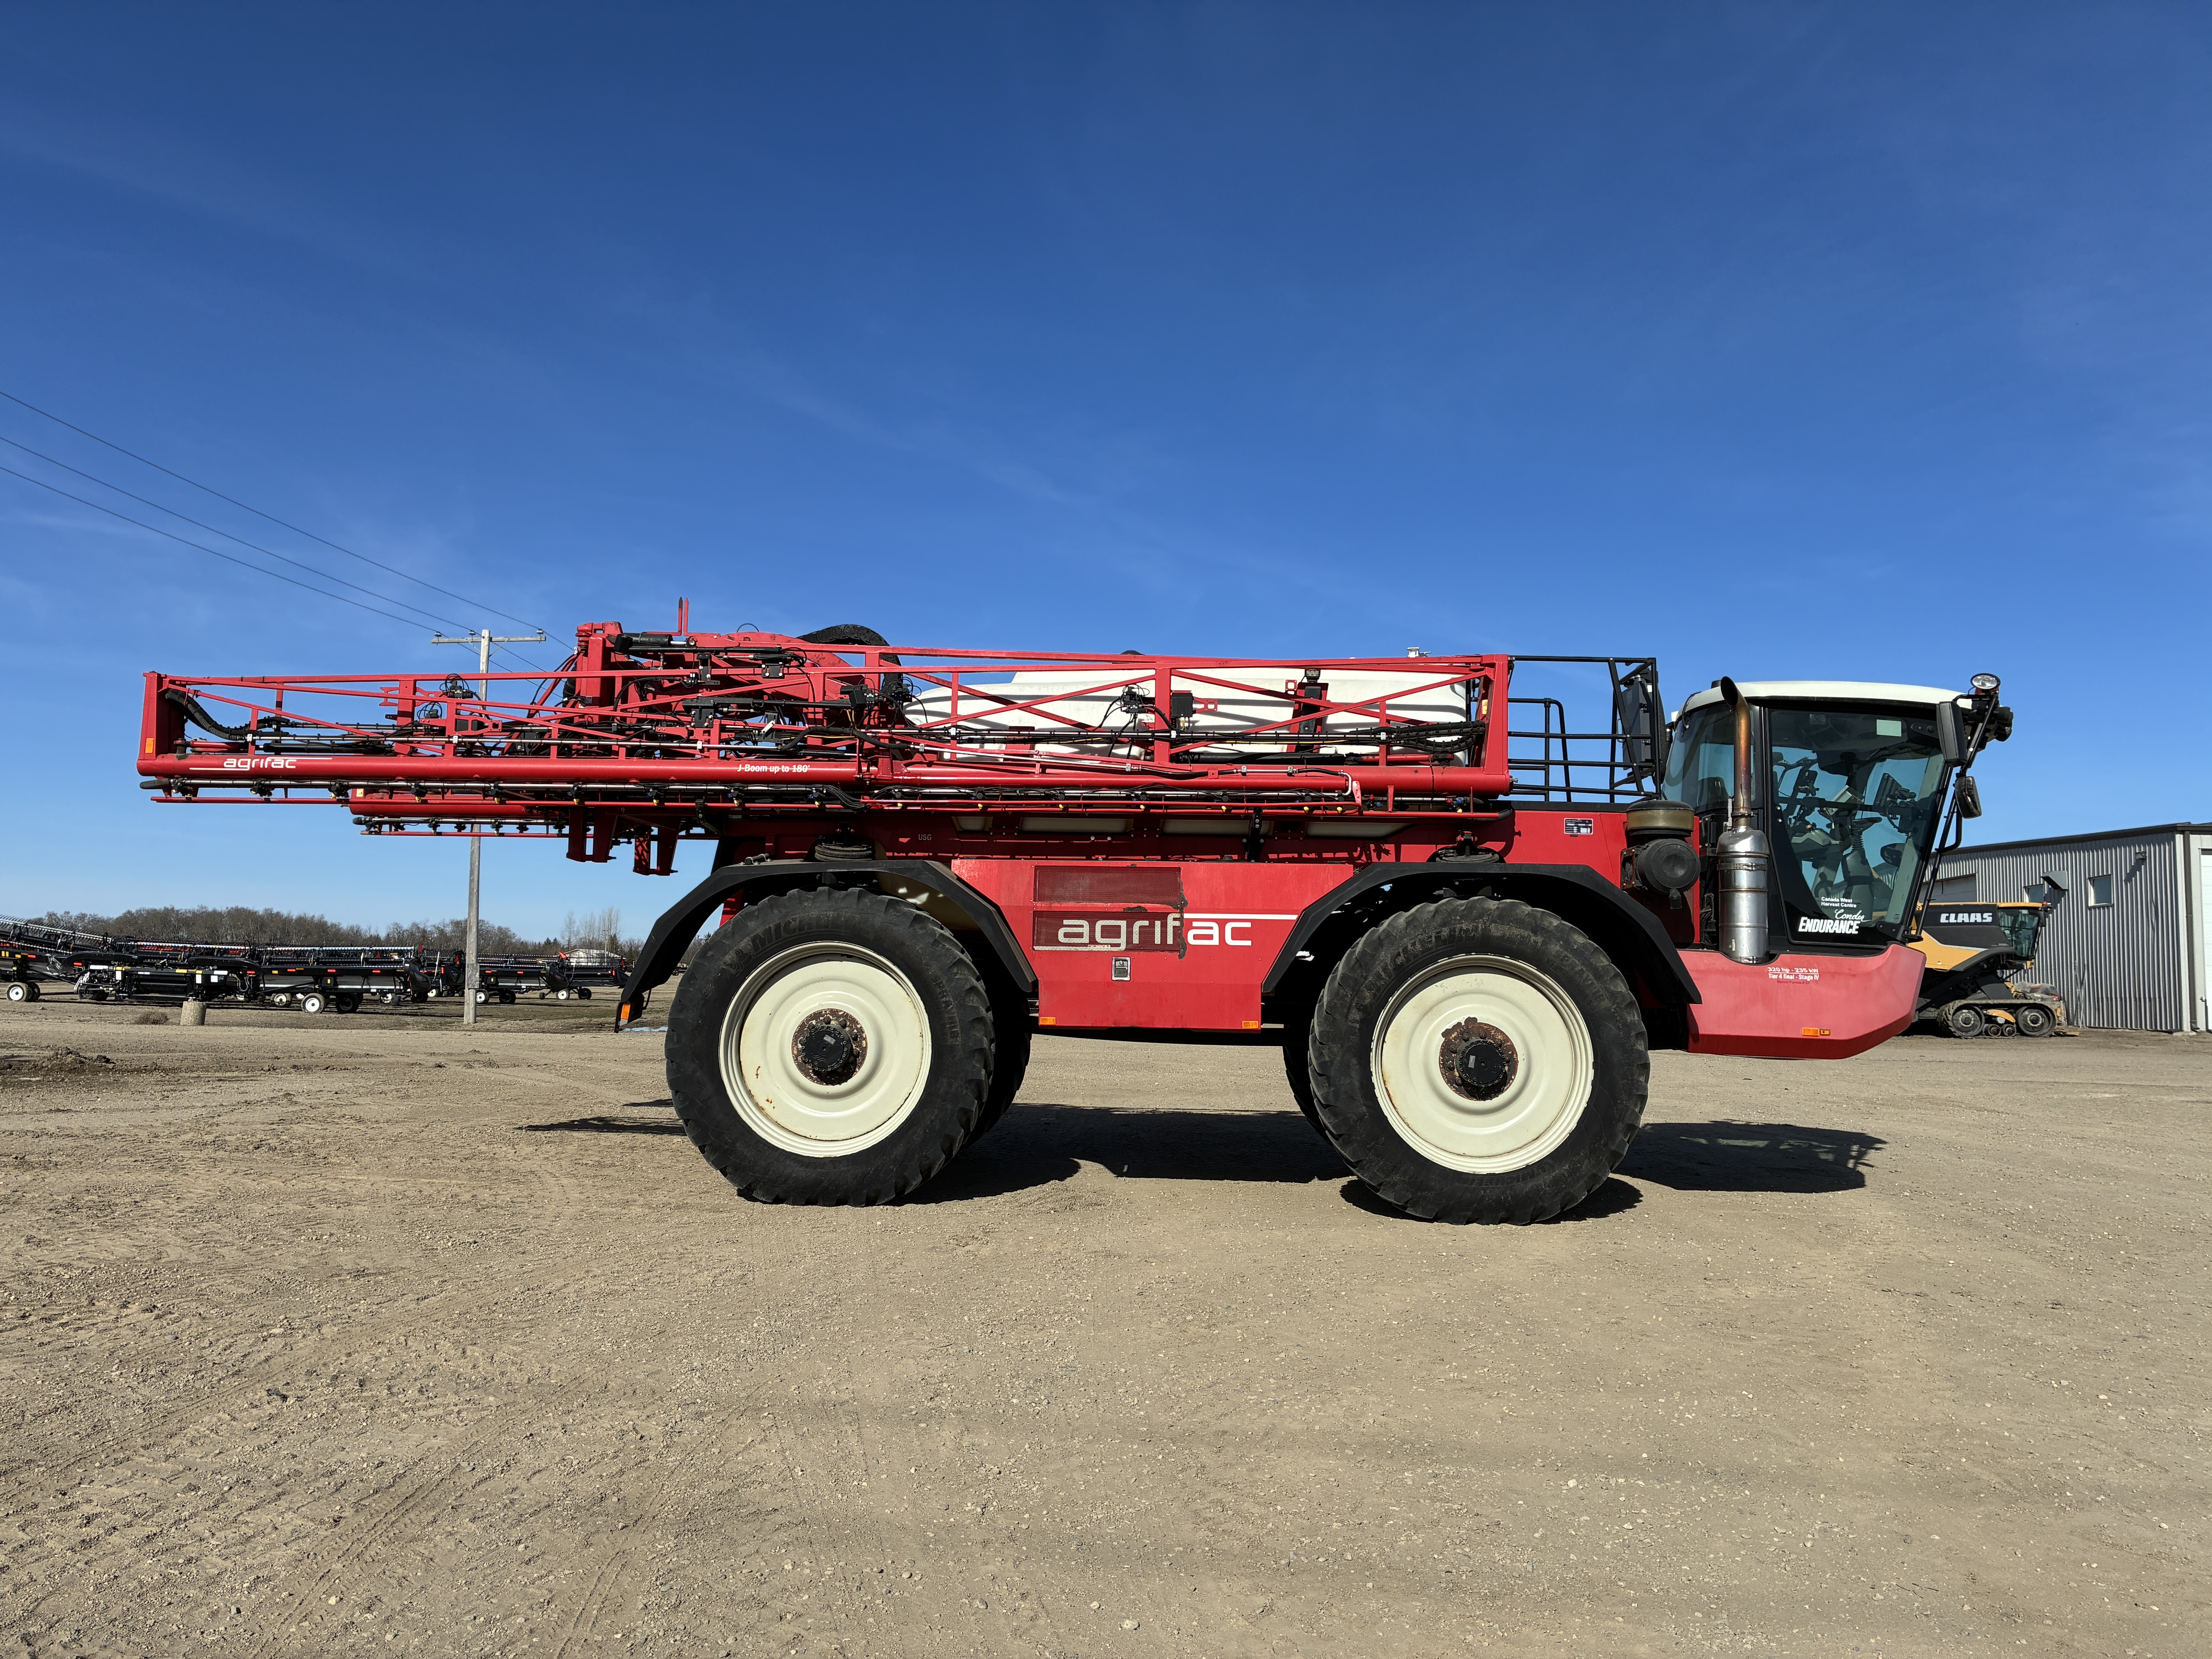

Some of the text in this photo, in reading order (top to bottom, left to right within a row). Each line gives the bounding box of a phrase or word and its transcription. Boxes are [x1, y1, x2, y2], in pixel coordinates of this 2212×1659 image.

[223, 757, 297, 771] agrifac
[769, 766, 780, 774] up
[1940, 913, 1992, 923] CLAAS
[1058, 913, 1252, 951] agrifac
[1798, 917, 1860, 934] ENDURANCE
